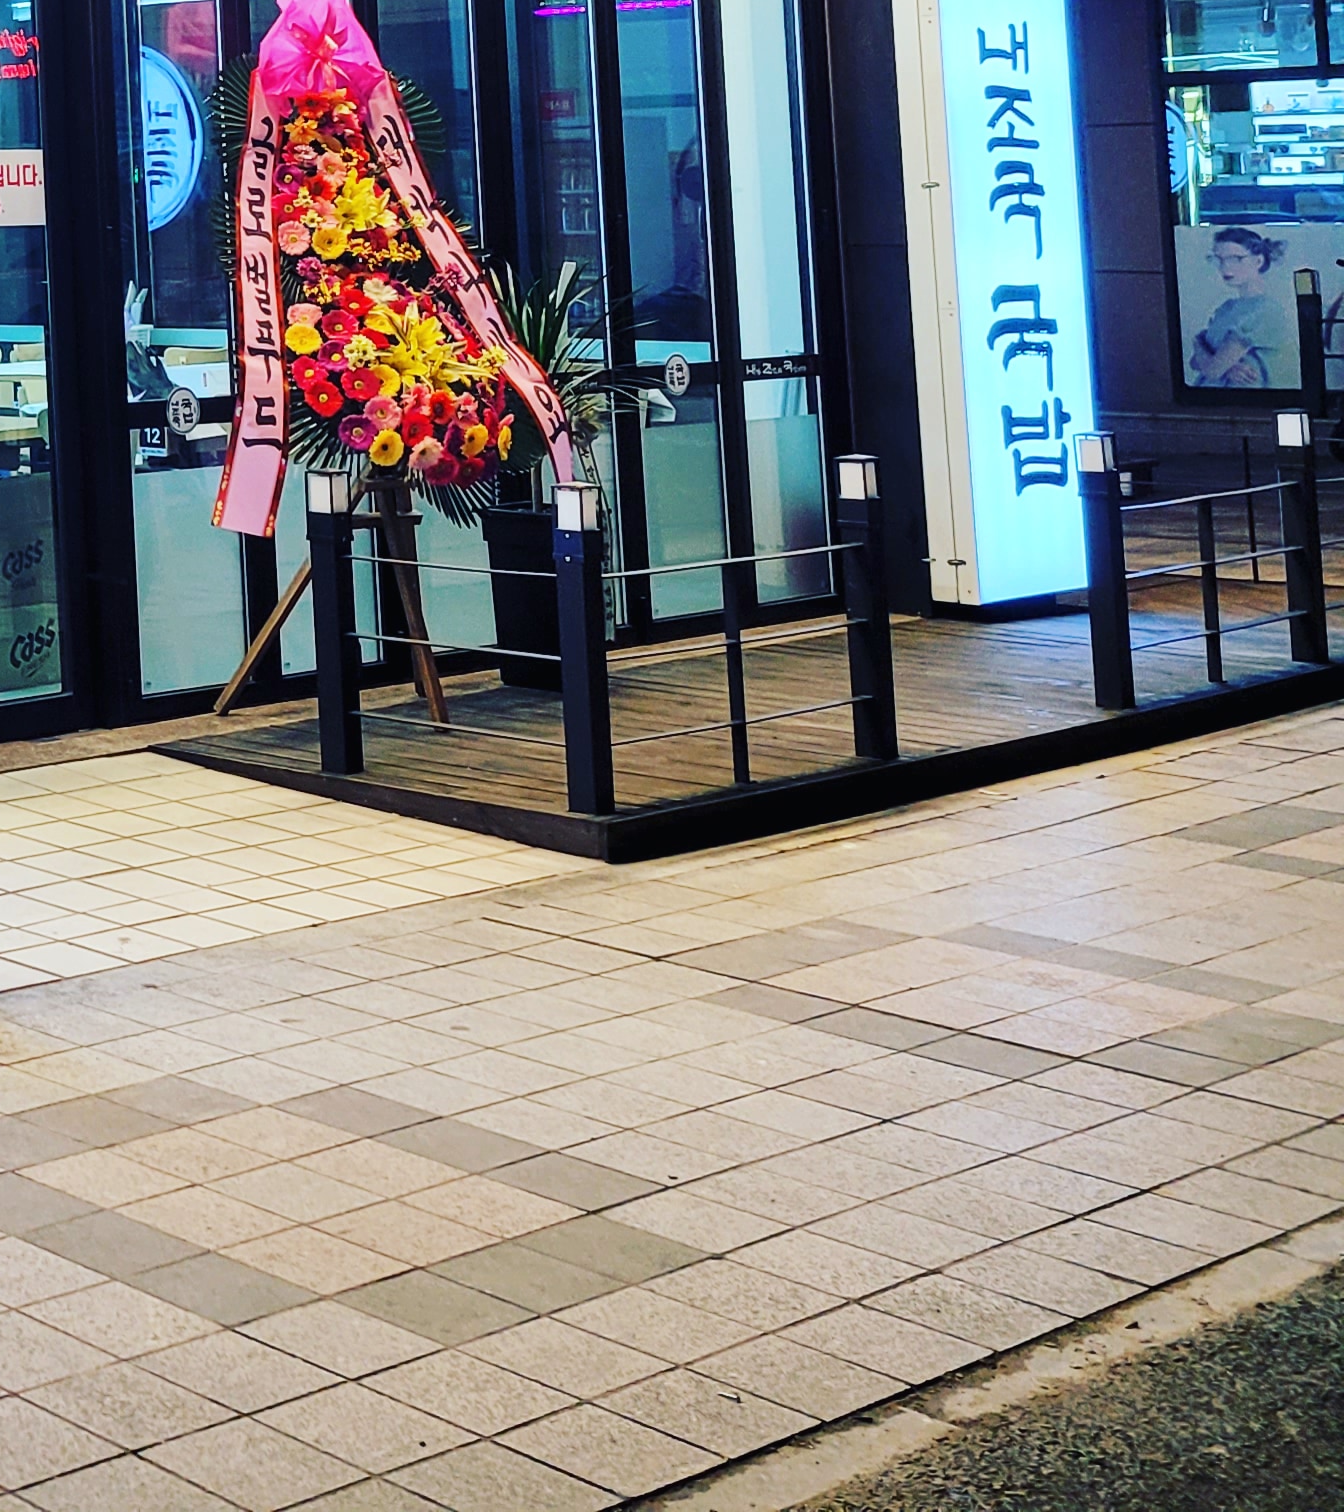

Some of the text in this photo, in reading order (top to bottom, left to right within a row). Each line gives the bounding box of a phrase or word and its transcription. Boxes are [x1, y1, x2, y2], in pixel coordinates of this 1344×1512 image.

[976, 21, 1071, 496] 내조국 국밥
[144, 428, 161, 444] 12
[10, 618, 56, 668] Cass
